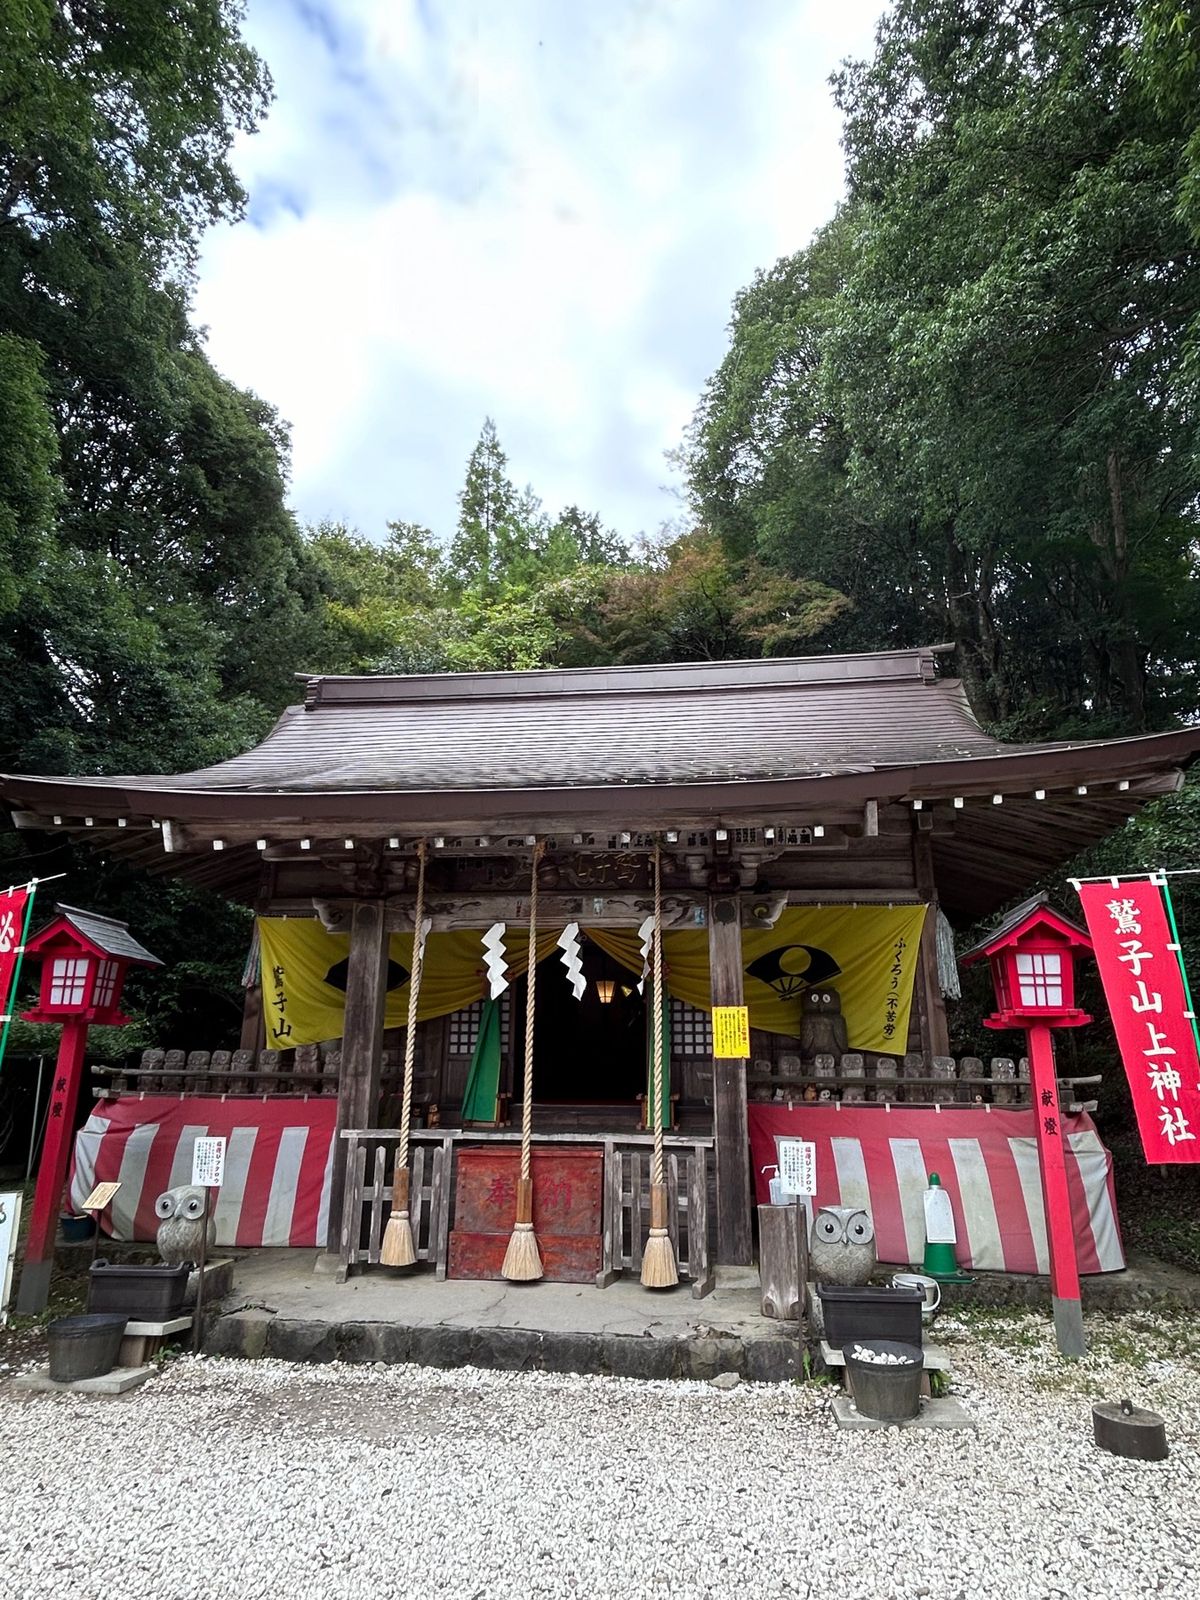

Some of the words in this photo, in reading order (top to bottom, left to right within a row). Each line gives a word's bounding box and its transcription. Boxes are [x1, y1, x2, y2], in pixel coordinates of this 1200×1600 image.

[1105, 898, 1197, 1146] 鷲子山上神社
